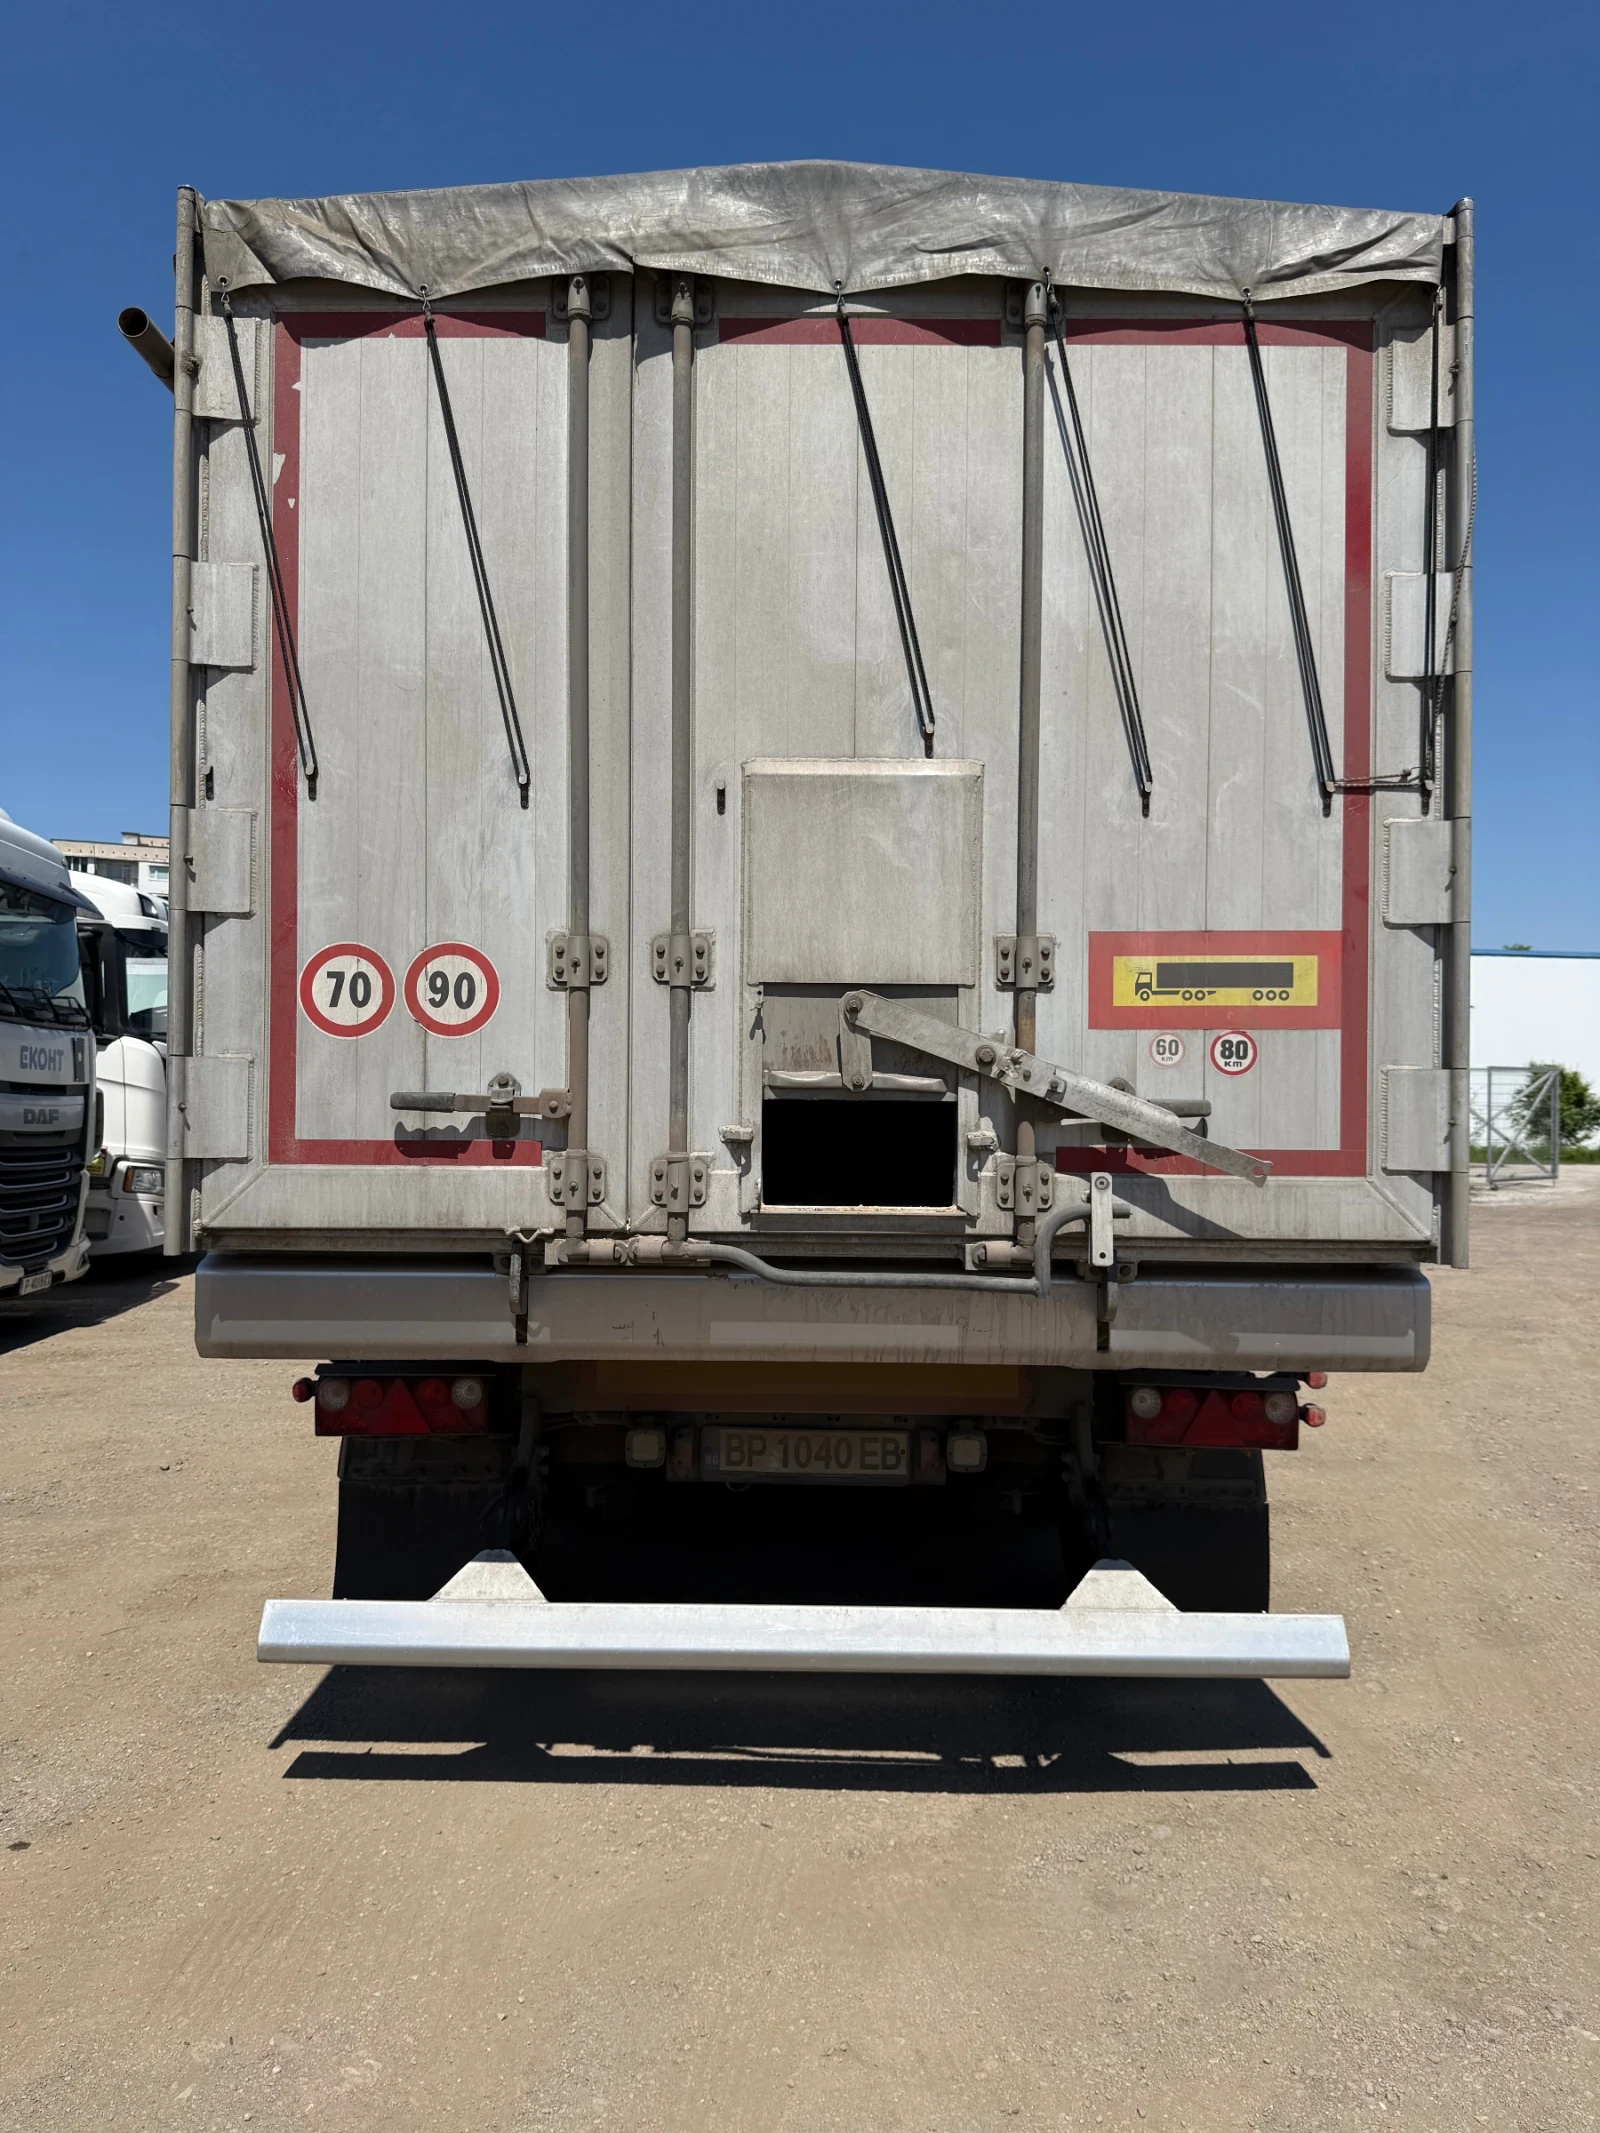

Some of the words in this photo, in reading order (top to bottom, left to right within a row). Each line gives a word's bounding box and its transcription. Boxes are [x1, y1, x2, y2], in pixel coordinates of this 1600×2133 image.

[326, 970, 372, 1008] 70
[428, 970, 476, 1010] 90
[1156, 1039, 1180, 1056] 60
[1220, 1039, 1249, 1060] 80
[23, 1108, 60, 1125] DAF
[778, 1435, 853, 1469] 1040
